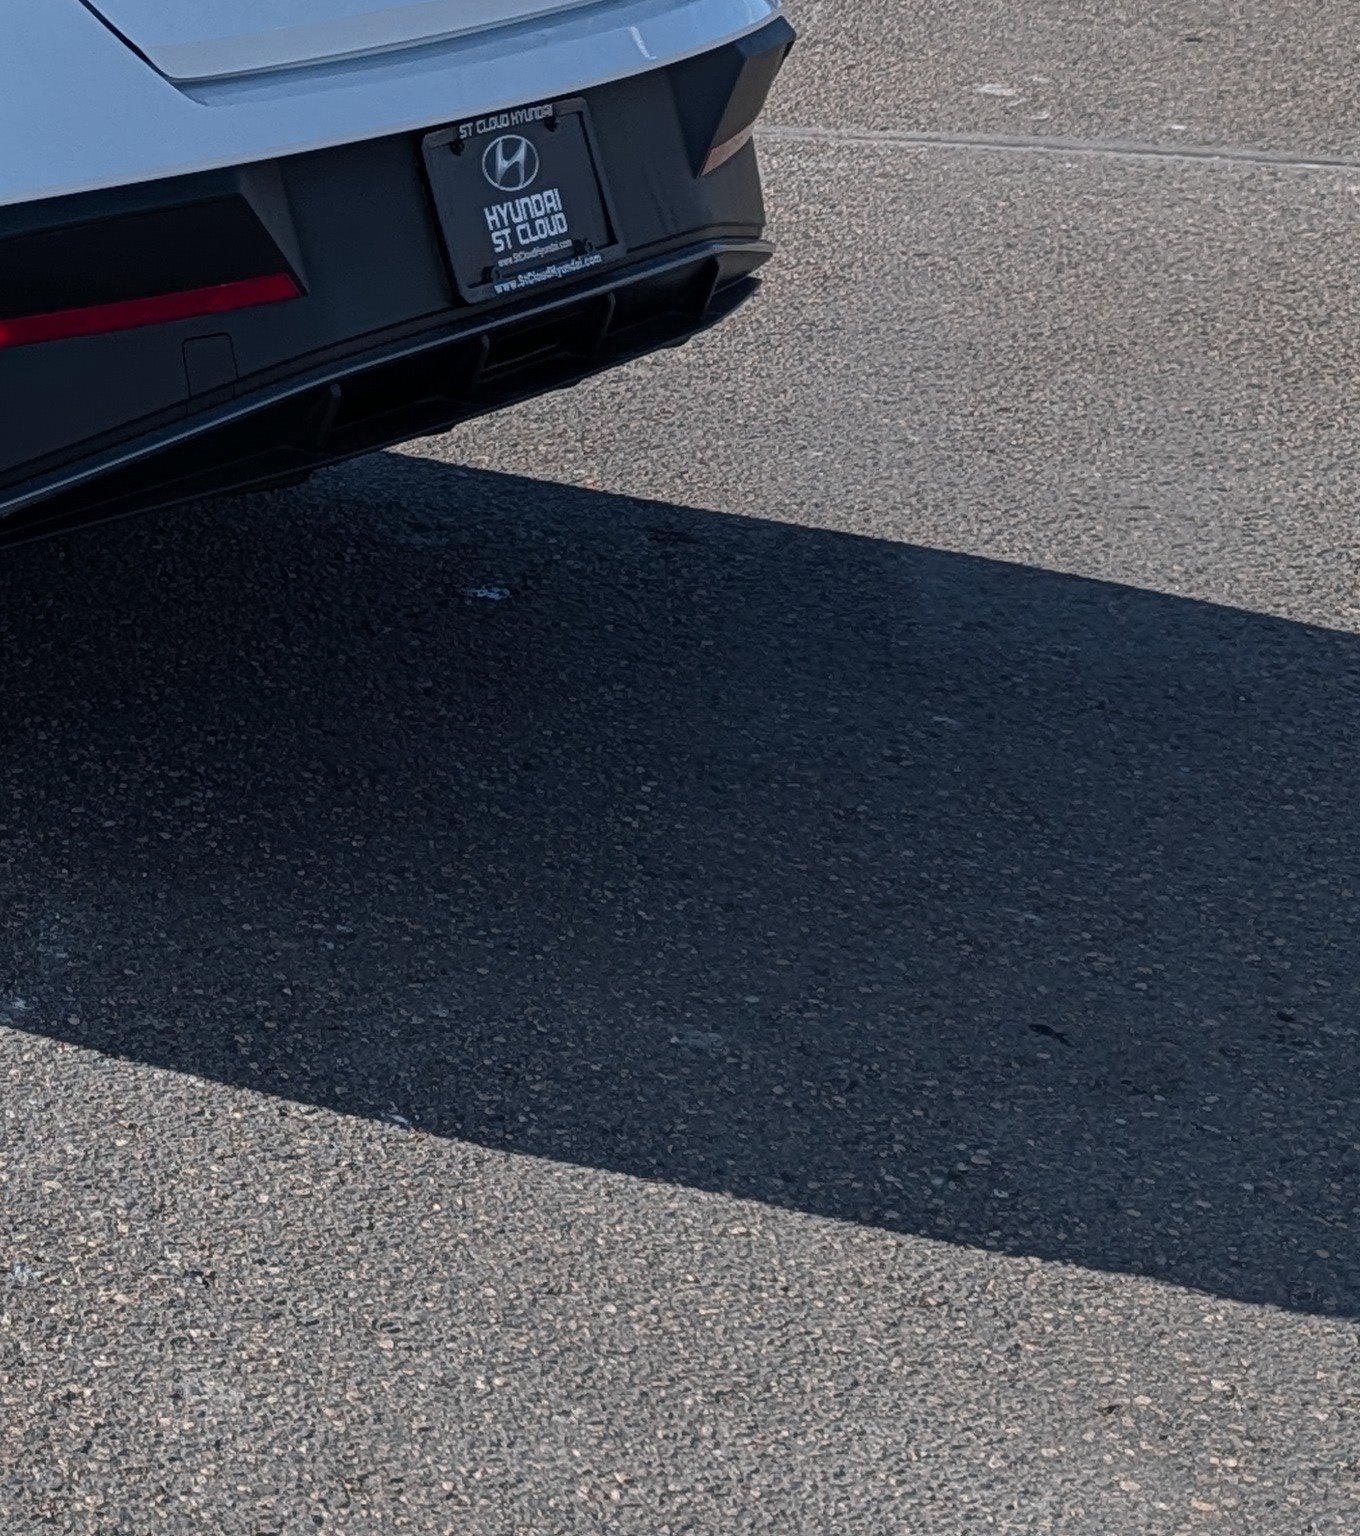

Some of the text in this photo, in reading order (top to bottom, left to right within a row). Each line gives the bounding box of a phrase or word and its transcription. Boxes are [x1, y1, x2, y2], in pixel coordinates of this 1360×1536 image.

[459, 104, 554, 139] ST CLOUD HYUNDAI
[484, 187, 563, 231] HYUNDAI
[491, 212, 568, 253] ST CLOUD
